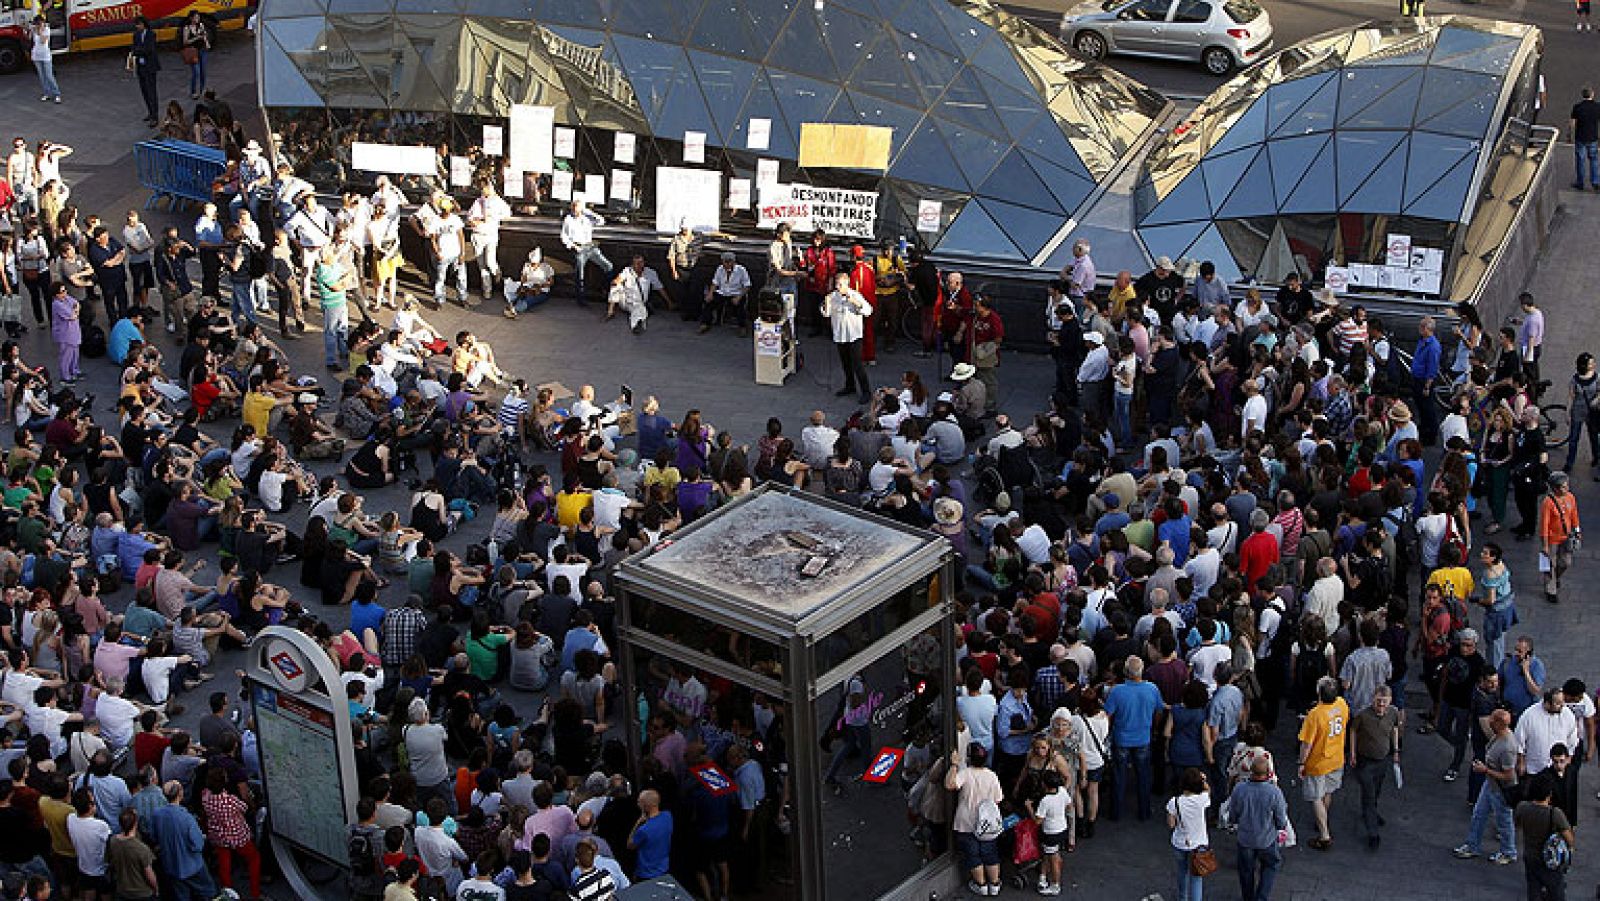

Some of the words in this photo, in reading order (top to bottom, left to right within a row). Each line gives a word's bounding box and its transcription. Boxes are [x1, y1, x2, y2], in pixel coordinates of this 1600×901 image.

[87, 4, 142, 23] SAMUR
[792, 187, 873, 207] DESMONTANDO
[762, 204, 808, 219] MENTIRAS
[812, 204, 872, 221] MENTIRAS
